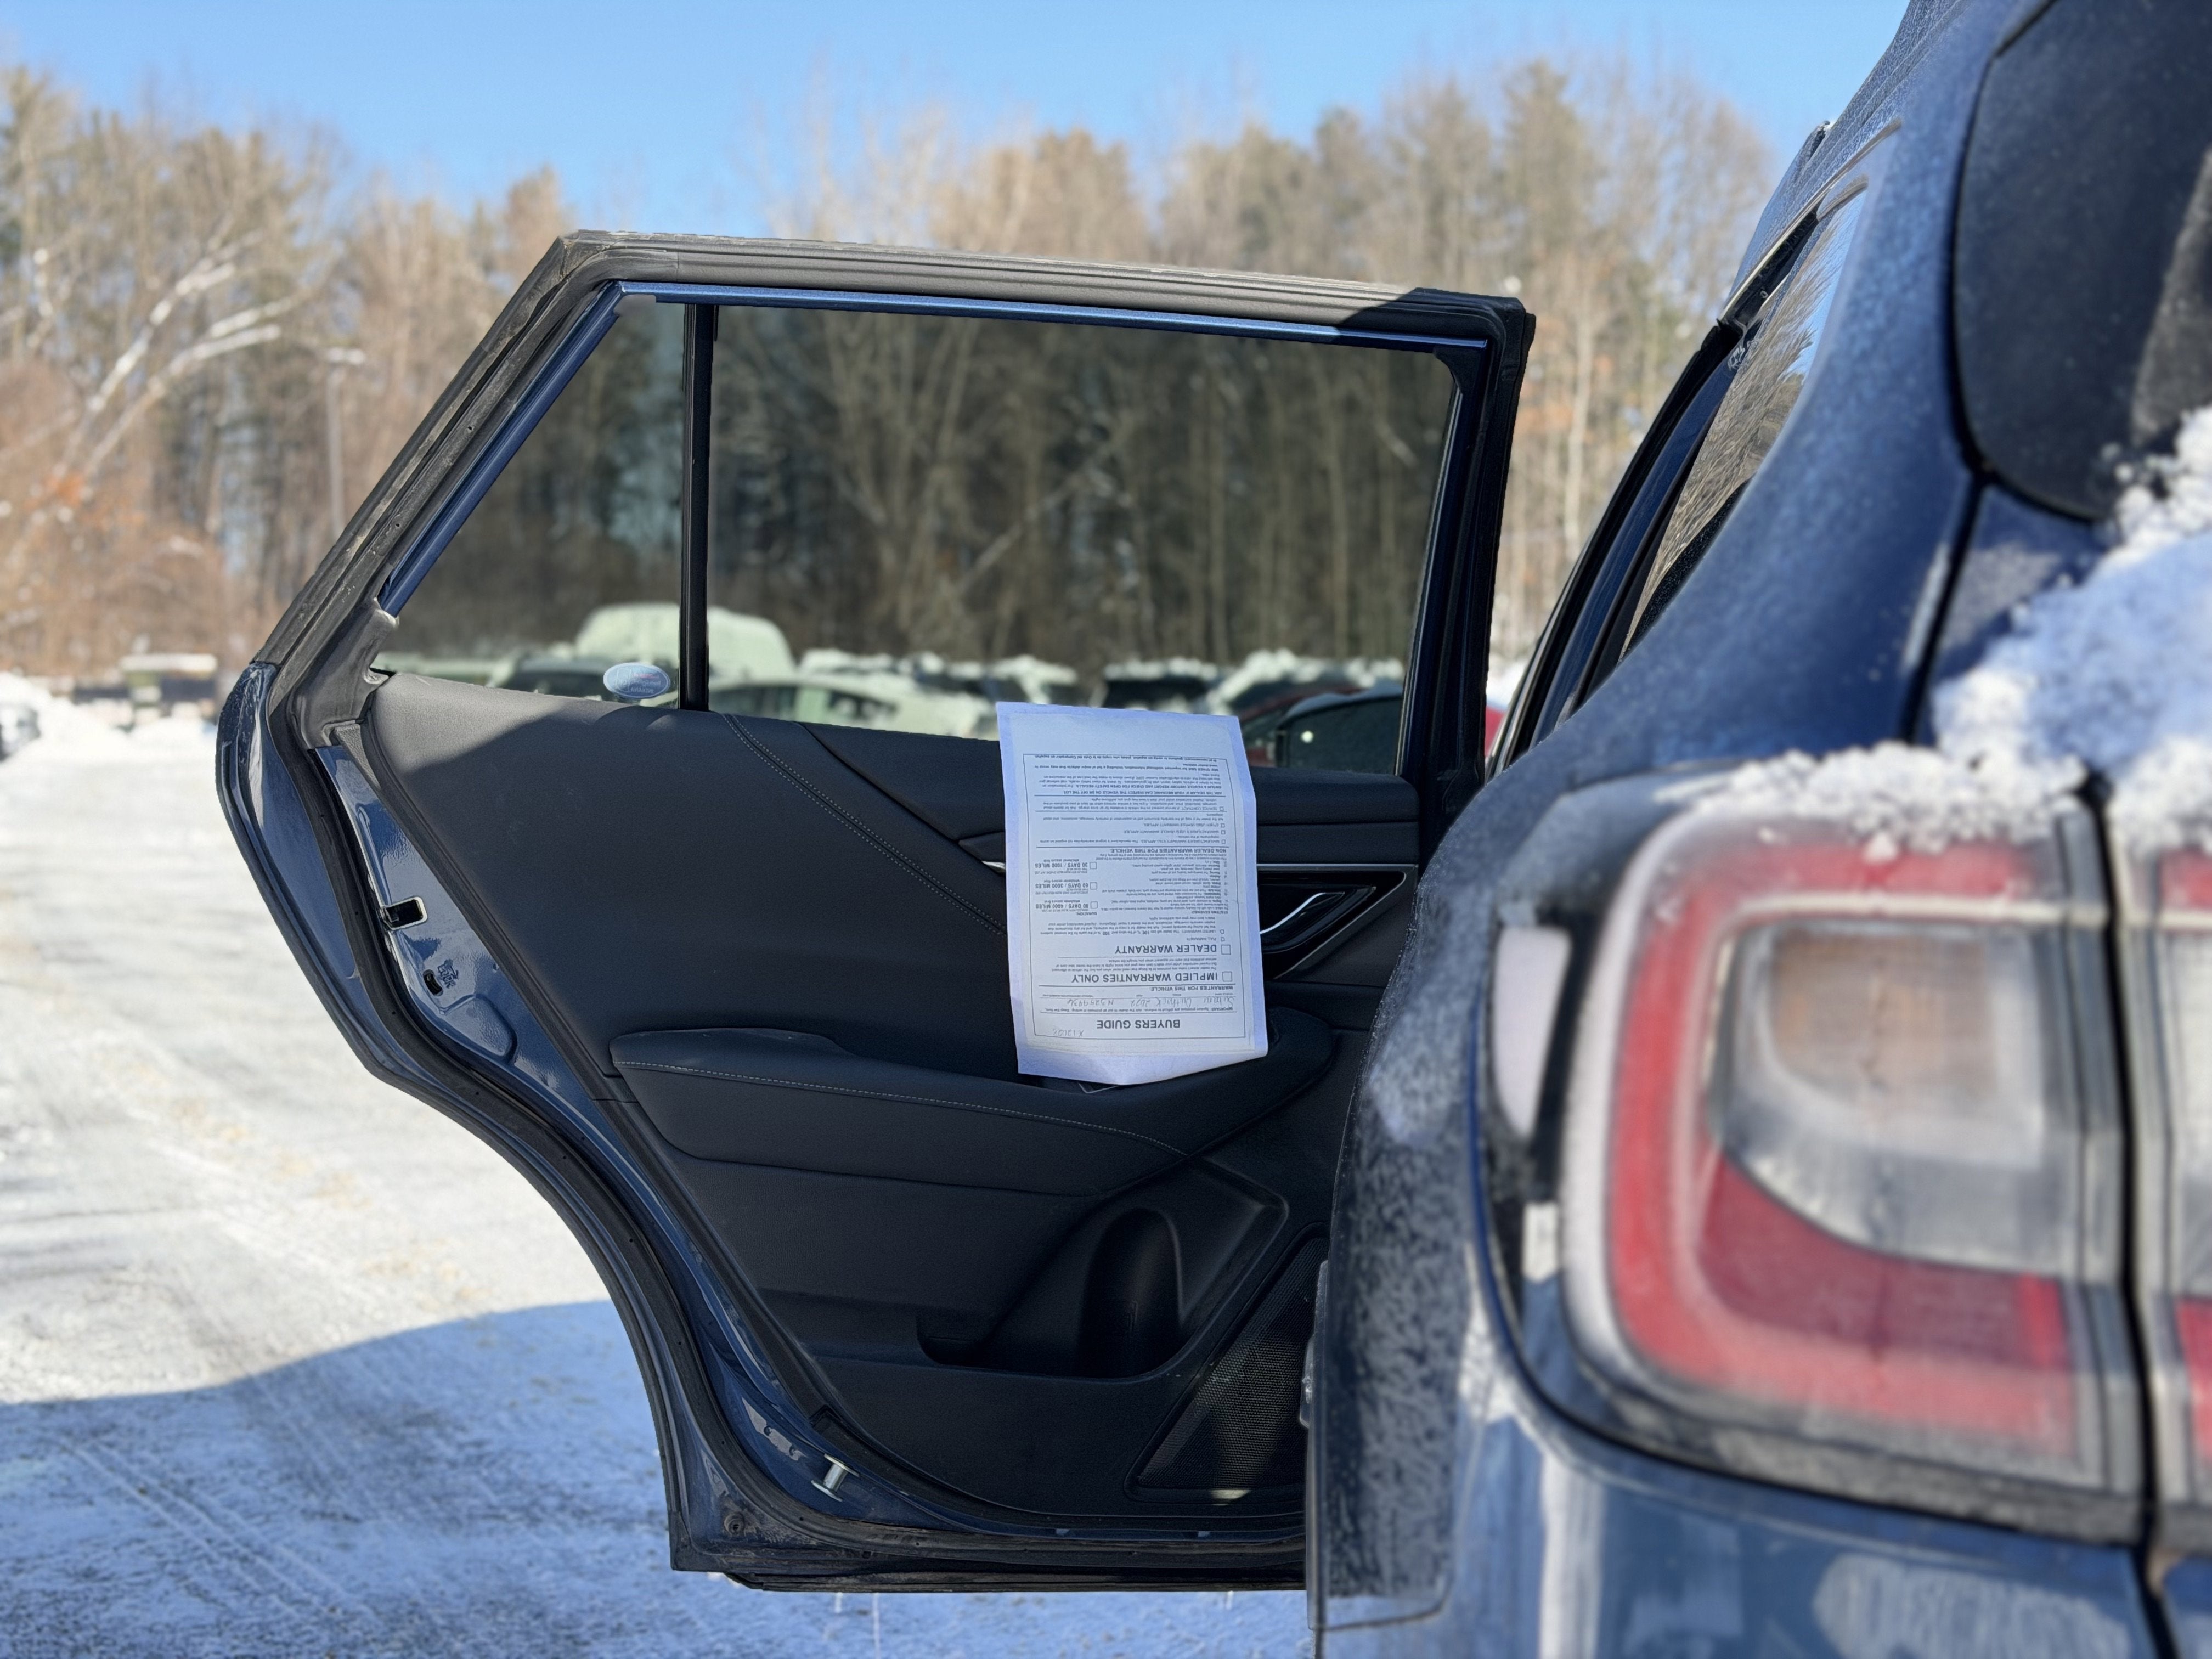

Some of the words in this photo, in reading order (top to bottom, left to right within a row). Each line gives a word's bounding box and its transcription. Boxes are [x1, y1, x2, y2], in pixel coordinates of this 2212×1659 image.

[1115, 945, 1173, 954] WARRANTY
[1176, 944, 1217, 953] DEALER
[1071, 974, 1099, 983] ONLY
[1103, 973, 1171, 983] WARRANTIES
[1175, 972, 1218, 981] IMPLIED
[1096, 1020, 1131, 1029] GUIDE
[1135, 1019, 1181, 1029] BUYERS
